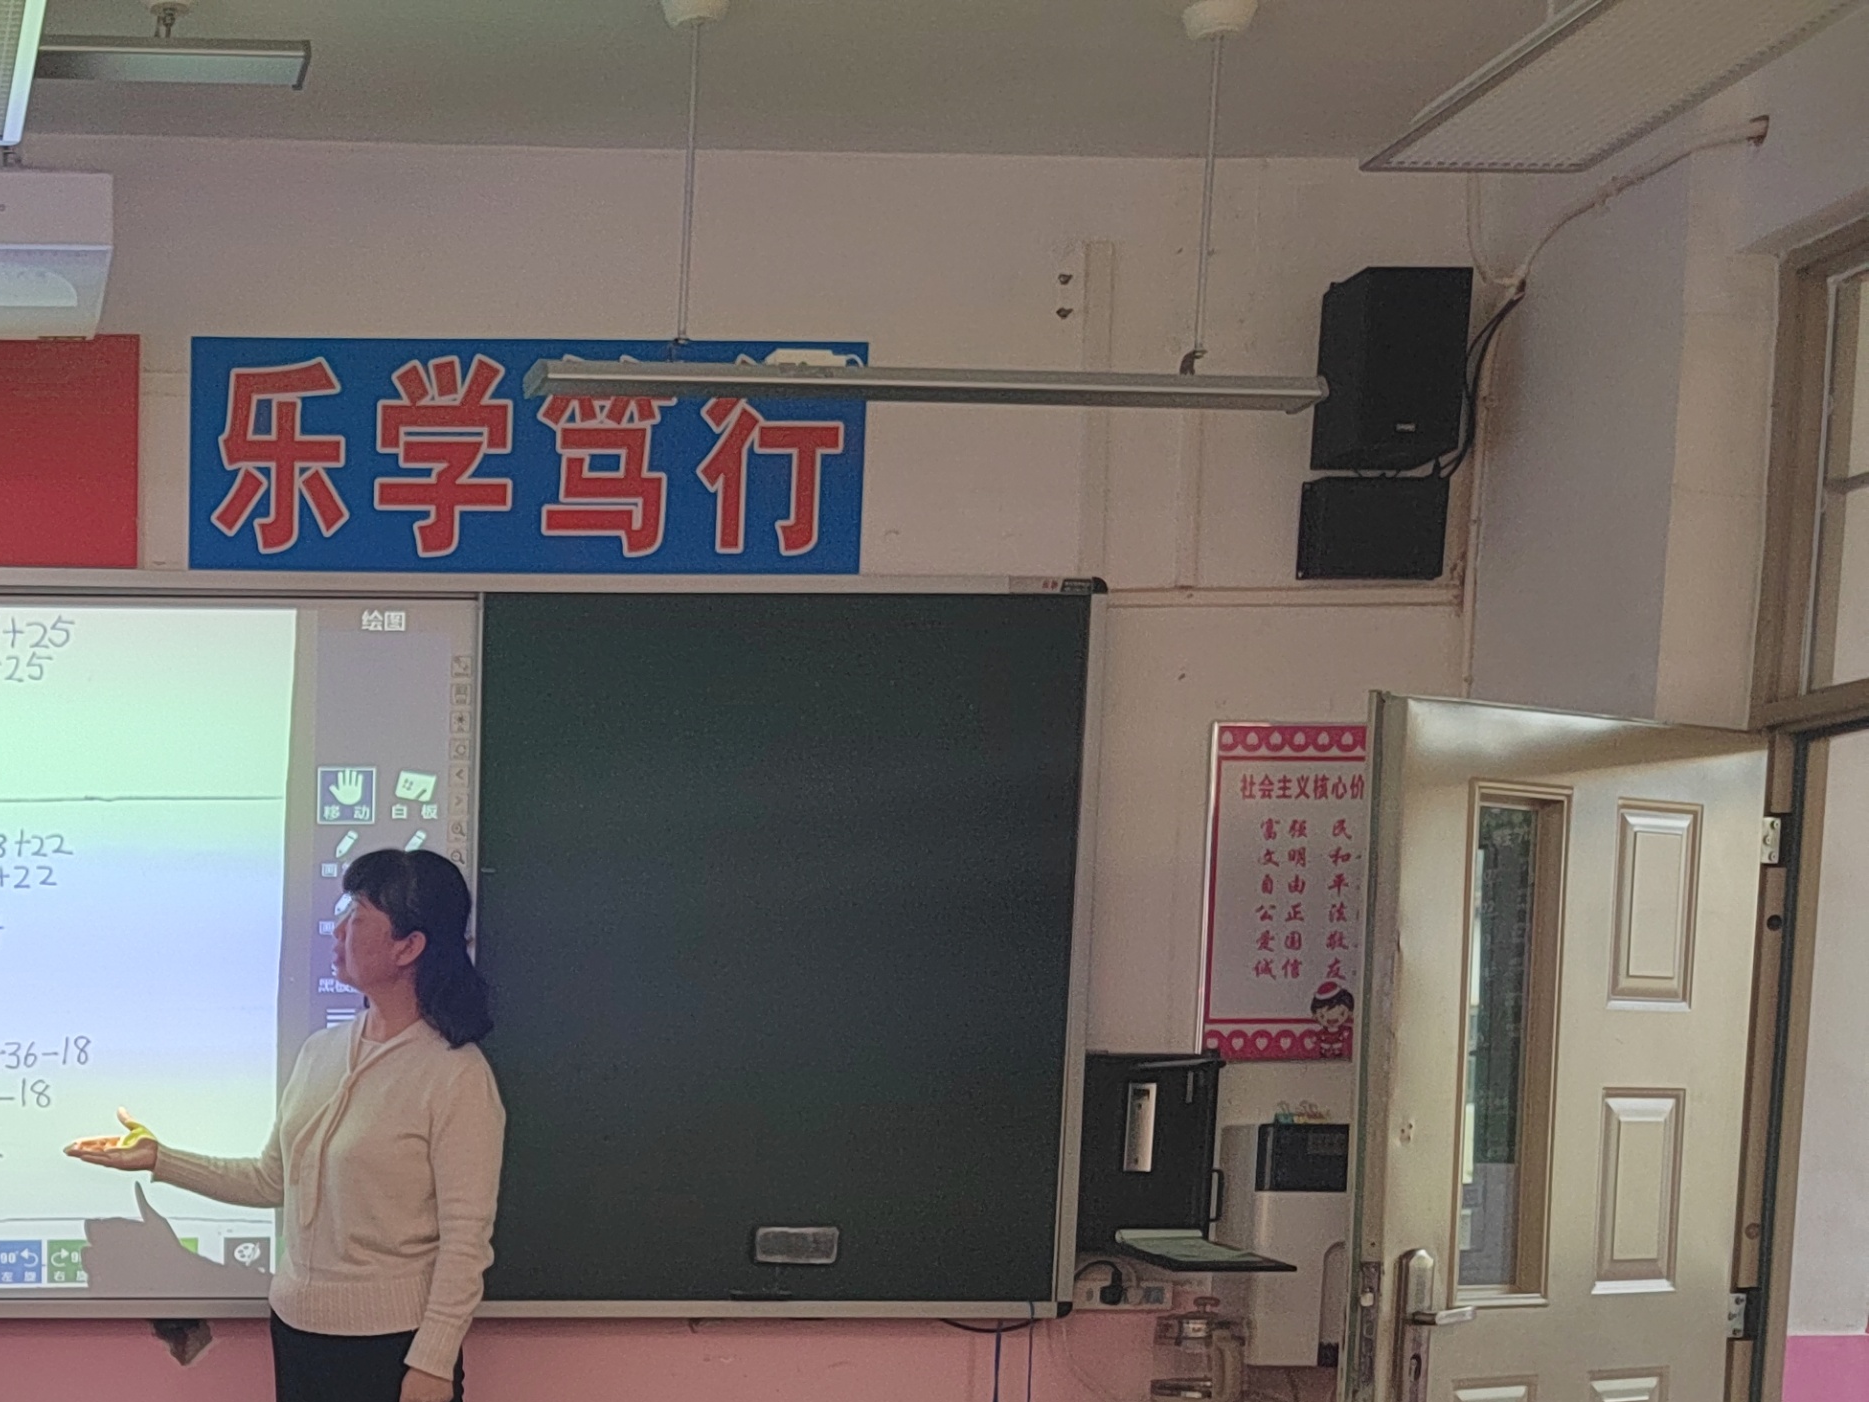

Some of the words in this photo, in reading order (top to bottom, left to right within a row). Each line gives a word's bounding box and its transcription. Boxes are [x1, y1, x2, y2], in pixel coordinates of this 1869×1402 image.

[210, 354, 844, 558] 乐学笃行
[360, 609, 406, 632] 绘图
[1240, 773, 1365, 800] 社会主义核心价
[323, 805, 370, 821] 移动
[391, 804, 438, 820] 白板
[1260, 817, 1308, 841] 富强
[1332, 818, 1353, 841] 民
[1258, 846, 1307, 868] 文明
[1329, 846, 1361, 867] 和
[1260, 873, 1307, 895] 自由
[1255, 902, 1305, 923] 公正
[1255, 929, 1303, 952] 爱国
[1254, 957, 1303, 981] 诚信
